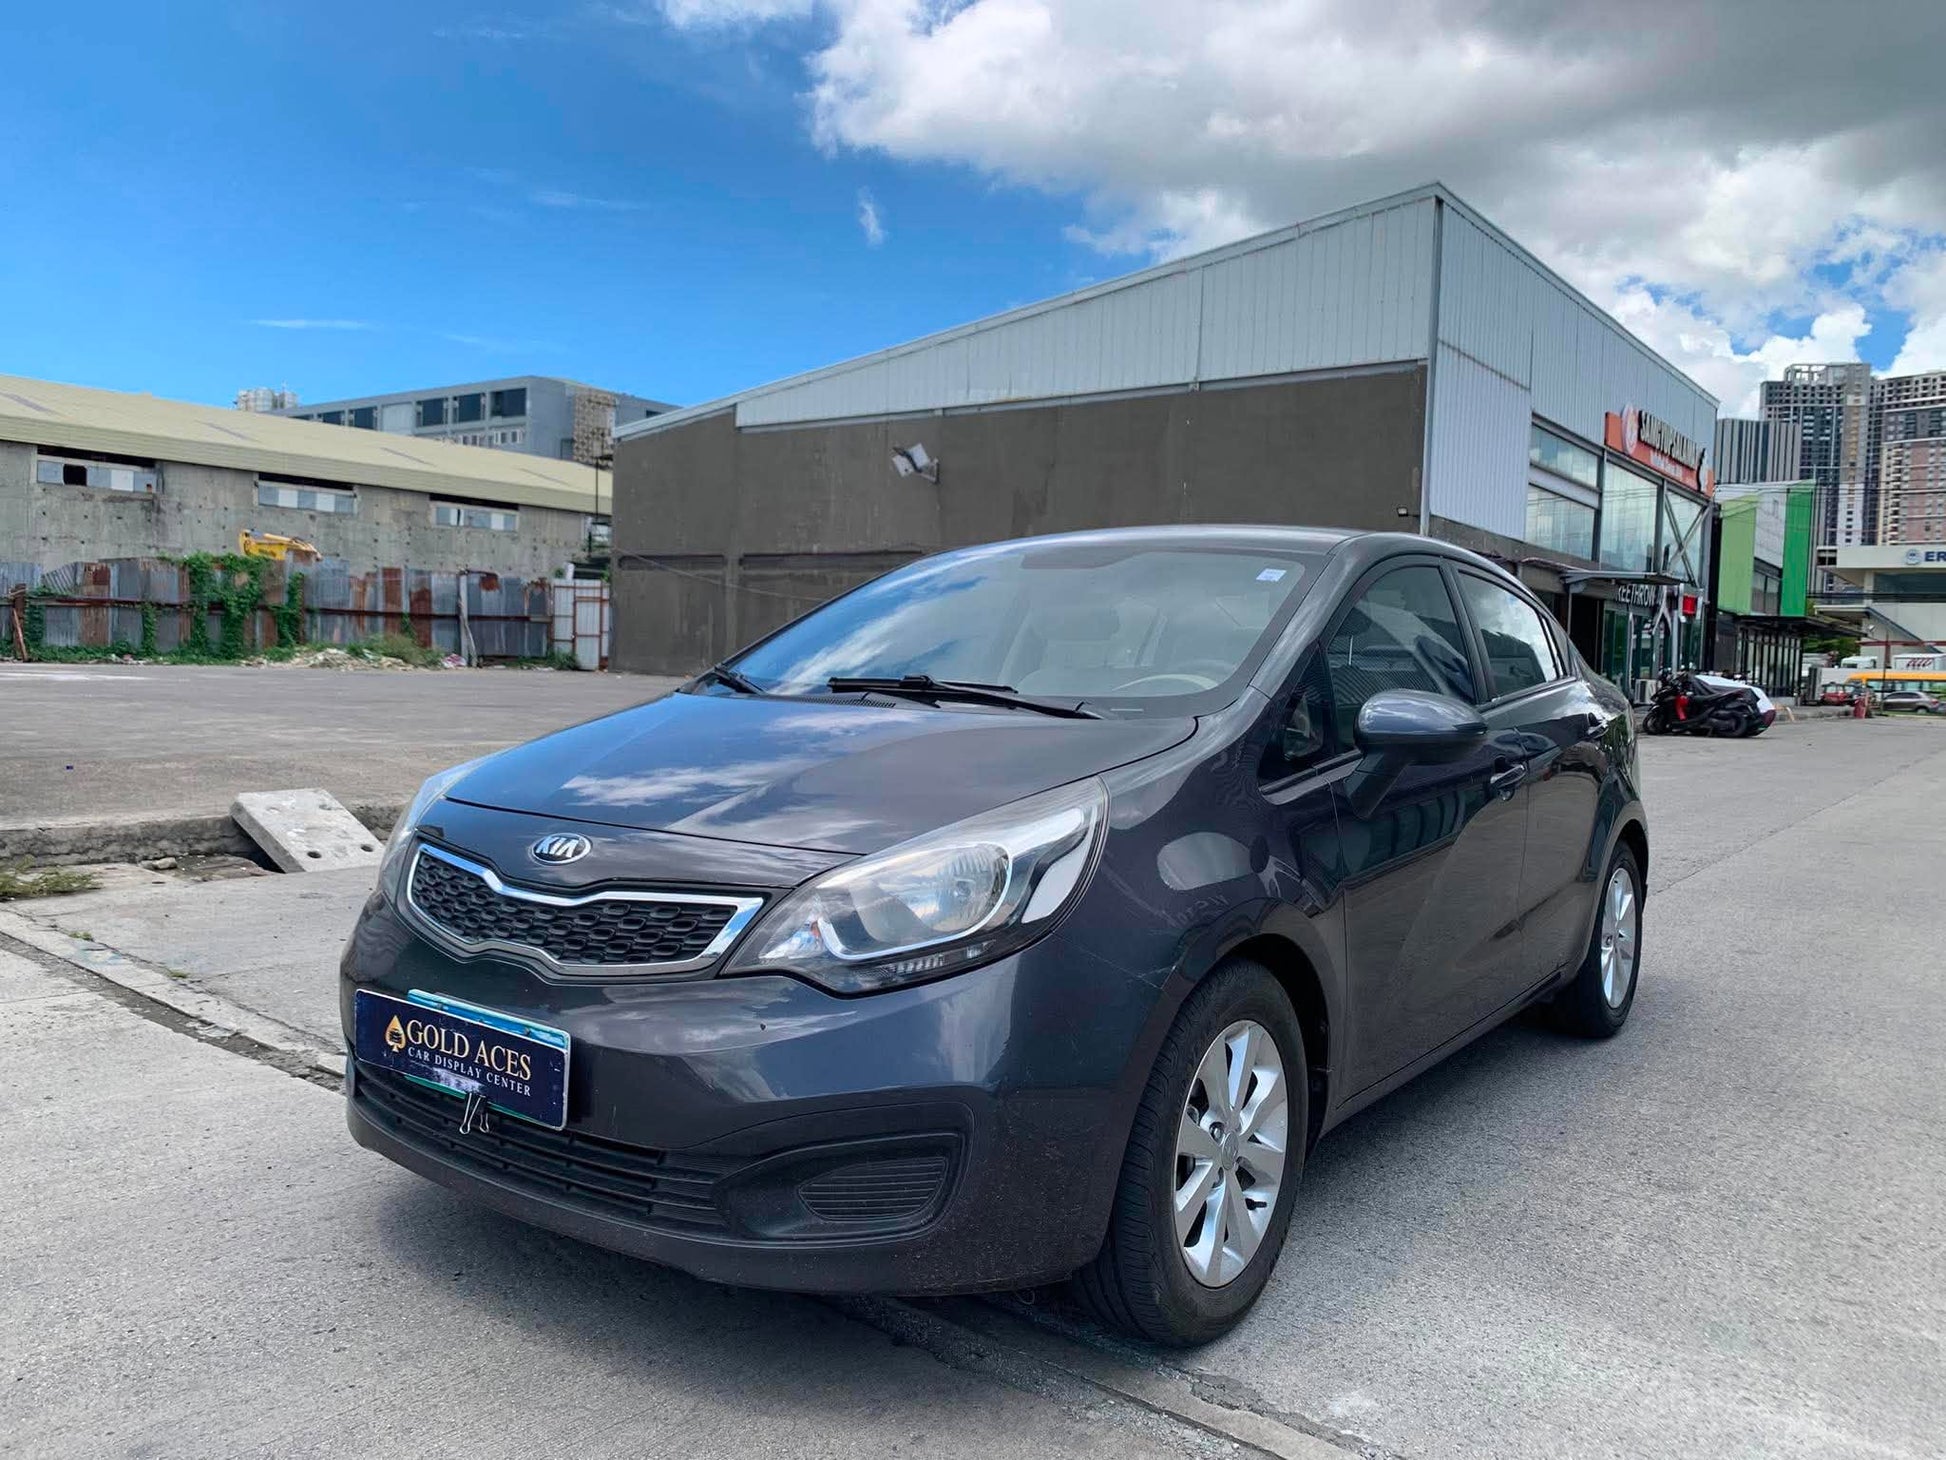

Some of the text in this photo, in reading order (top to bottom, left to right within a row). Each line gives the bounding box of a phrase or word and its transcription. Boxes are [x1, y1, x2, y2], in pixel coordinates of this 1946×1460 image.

[535, 836, 579, 858] KIA
[406, 1019, 531, 1081] GOLD ACES
[407, 1046, 531, 1097] CAR DISPLAY CENTER
